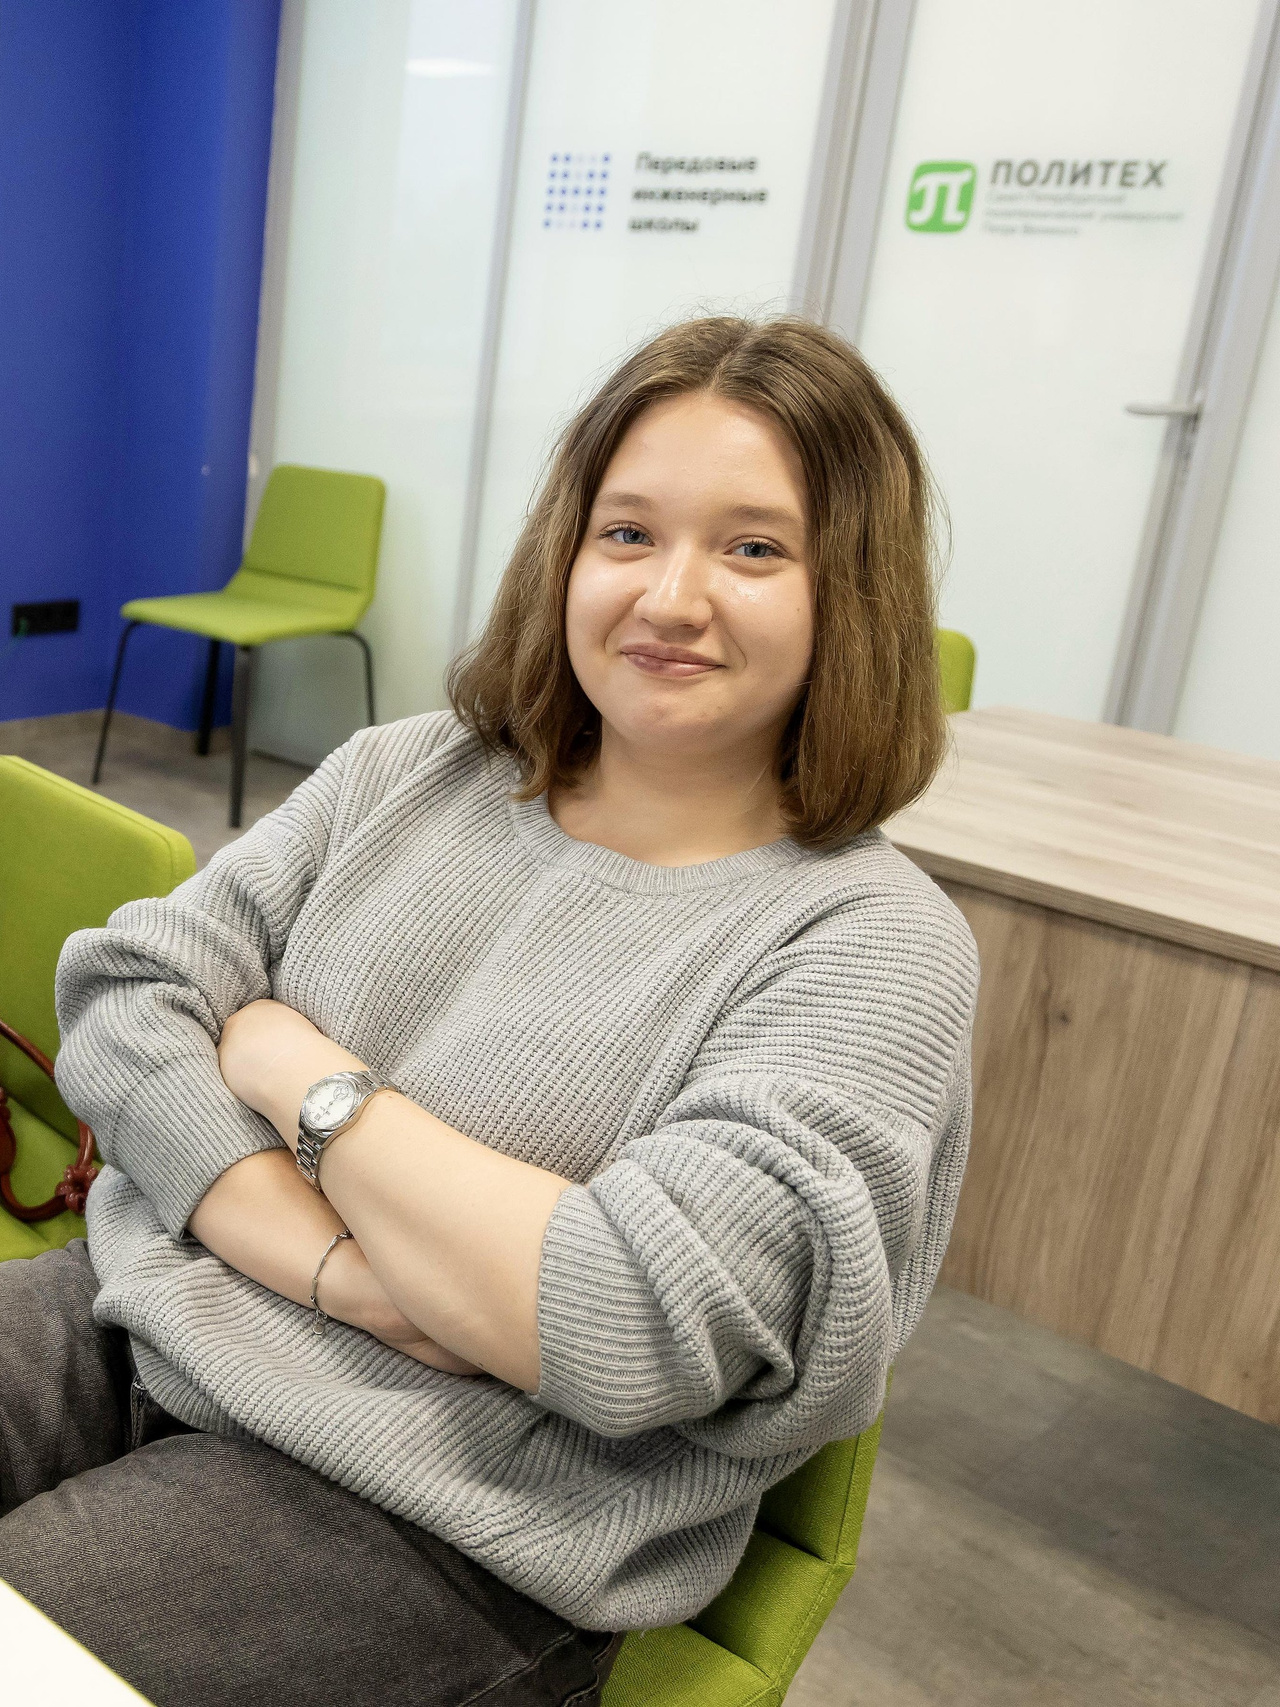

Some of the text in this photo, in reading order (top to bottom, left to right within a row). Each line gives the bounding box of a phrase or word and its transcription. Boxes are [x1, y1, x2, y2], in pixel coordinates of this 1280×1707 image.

[634, 151, 758, 175] Передовые
[989, 159, 1166, 188] ПОЛИТЕХ
[632, 187, 768, 209] инженерные
[627, 216, 700, 233] школы
